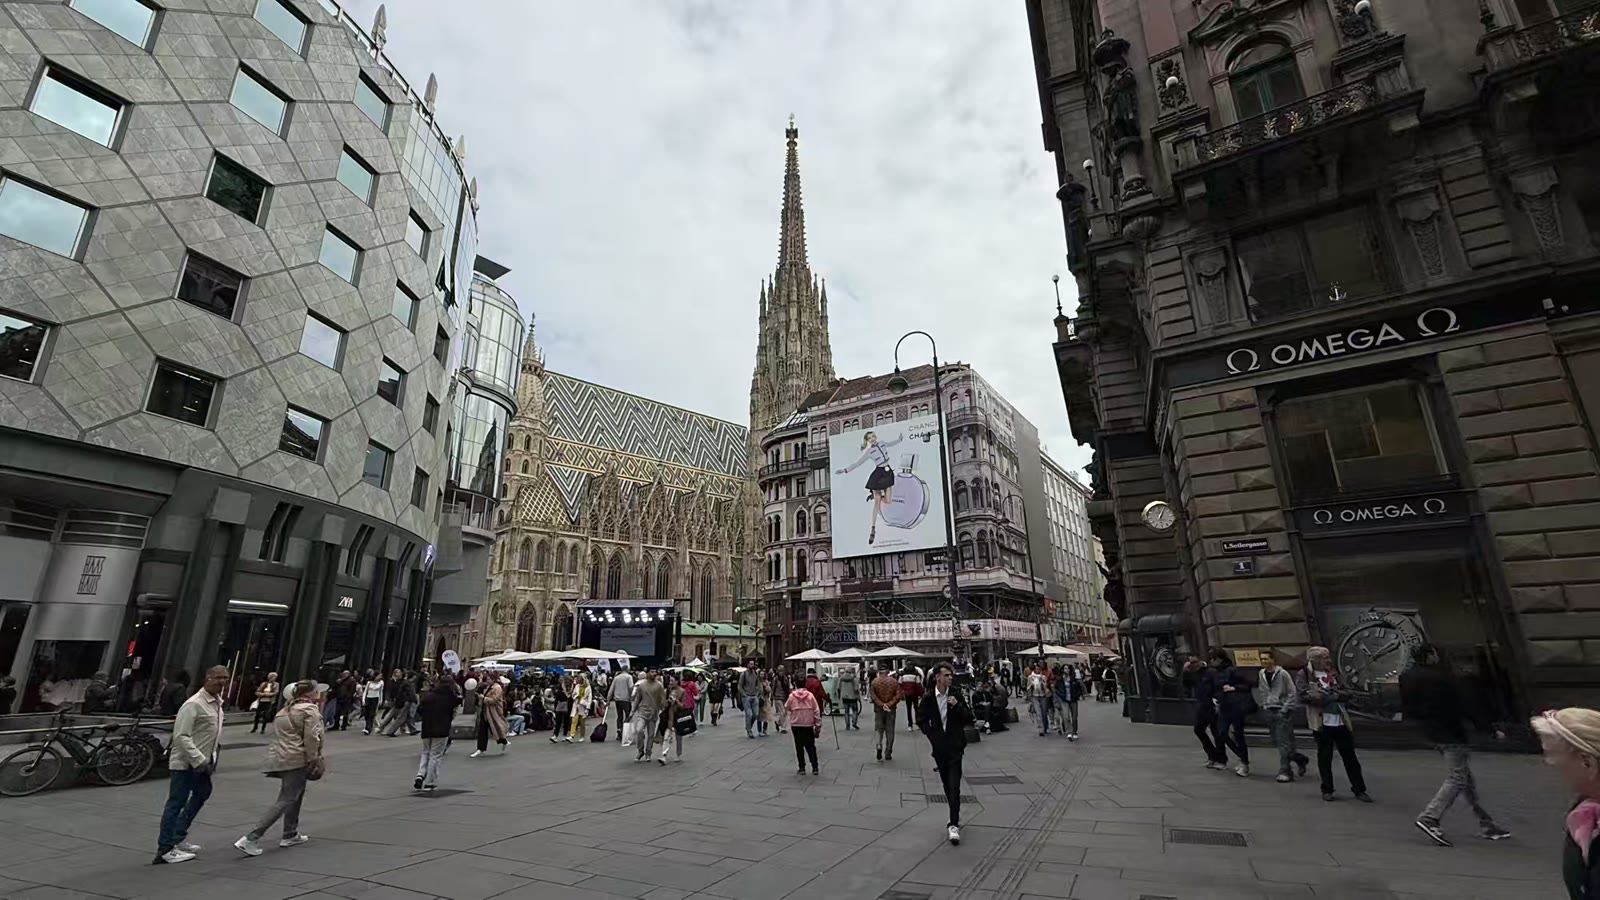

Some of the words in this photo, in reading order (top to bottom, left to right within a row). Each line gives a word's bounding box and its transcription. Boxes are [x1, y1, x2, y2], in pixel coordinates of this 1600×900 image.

[1271, 323, 1405, 365] OMEGA
[1340, 503, 1416, 522] OMEGA
[83, 557, 105, 574] HAAS
[1238, 562, 1245, 570] 1
[78, 576, 101, 593] HAUS
[915, 626, 936, 634] COFFEE
